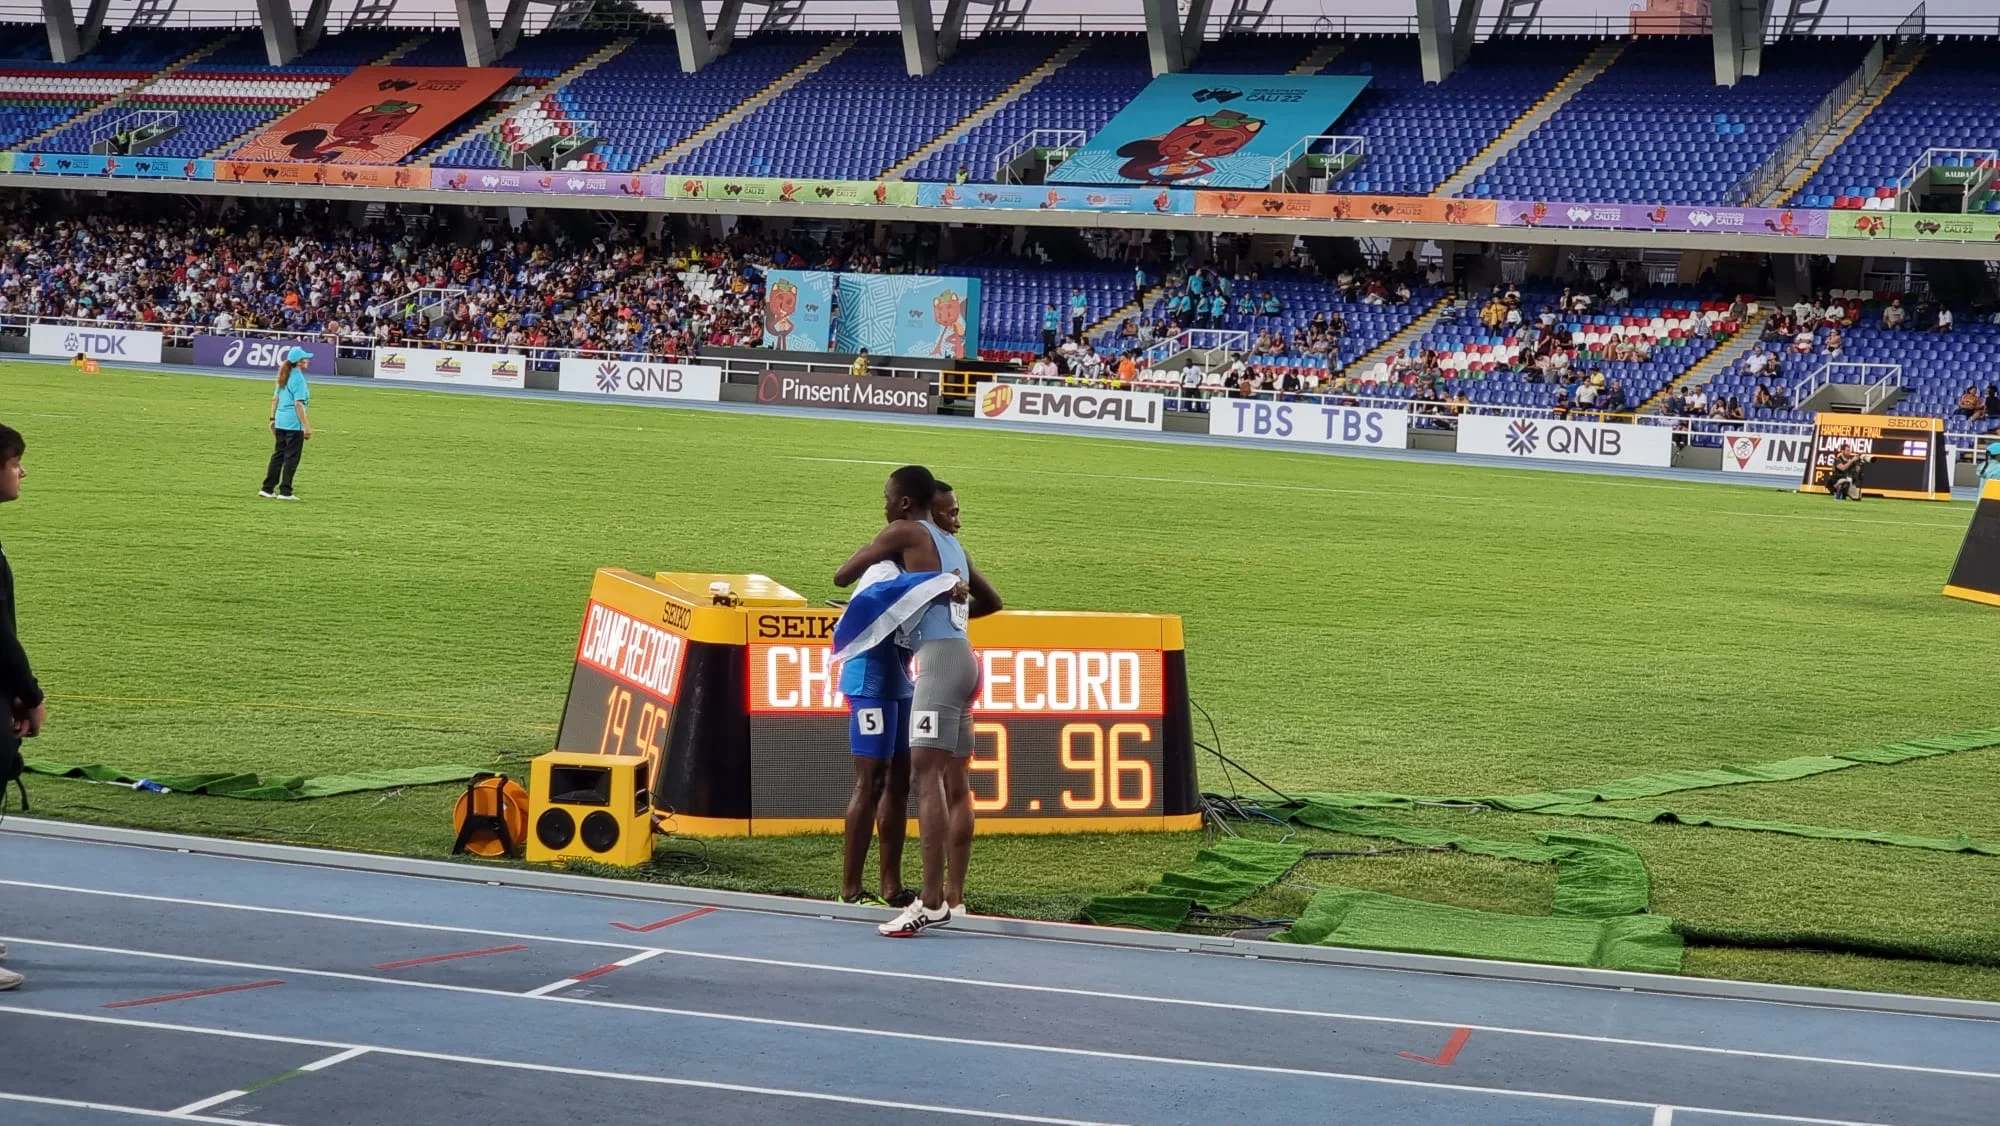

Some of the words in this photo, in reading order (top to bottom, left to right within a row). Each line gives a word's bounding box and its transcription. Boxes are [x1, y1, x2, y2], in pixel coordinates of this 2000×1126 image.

[1245, 94, 1278, 102] CALI
[1280, 94, 1303, 102] 22
[80, 334, 126, 355] TDK
[247, 343, 291, 366] asic
[627, 367, 683, 392] QNB
[782, 378, 850, 403] Pinsent
[853, 383, 928, 408] Masons
[1019, 391, 1156, 423] EMCALI
[1233, 402, 1293, 437] TBS
[1322, 408, 1383, 443] TBS
[1820, 425, 1851, 436] HAMMER
[1854, 427, 1861, 437] M
[1863, 427, 1882, 438] FINAL
[1888, 419, 1928, 428] SEIKO
[1547, 425, 1621, 456] QNB
[1767, 440, 1811, 463] IND
[662, 601, 692, 631] SEIKO
[758, 615, 837, 639] SEIK
[972, 650, 1140, 710] ECORD
[865, 713, 876, 731] 5
[917, 716, 932, 733] 4
